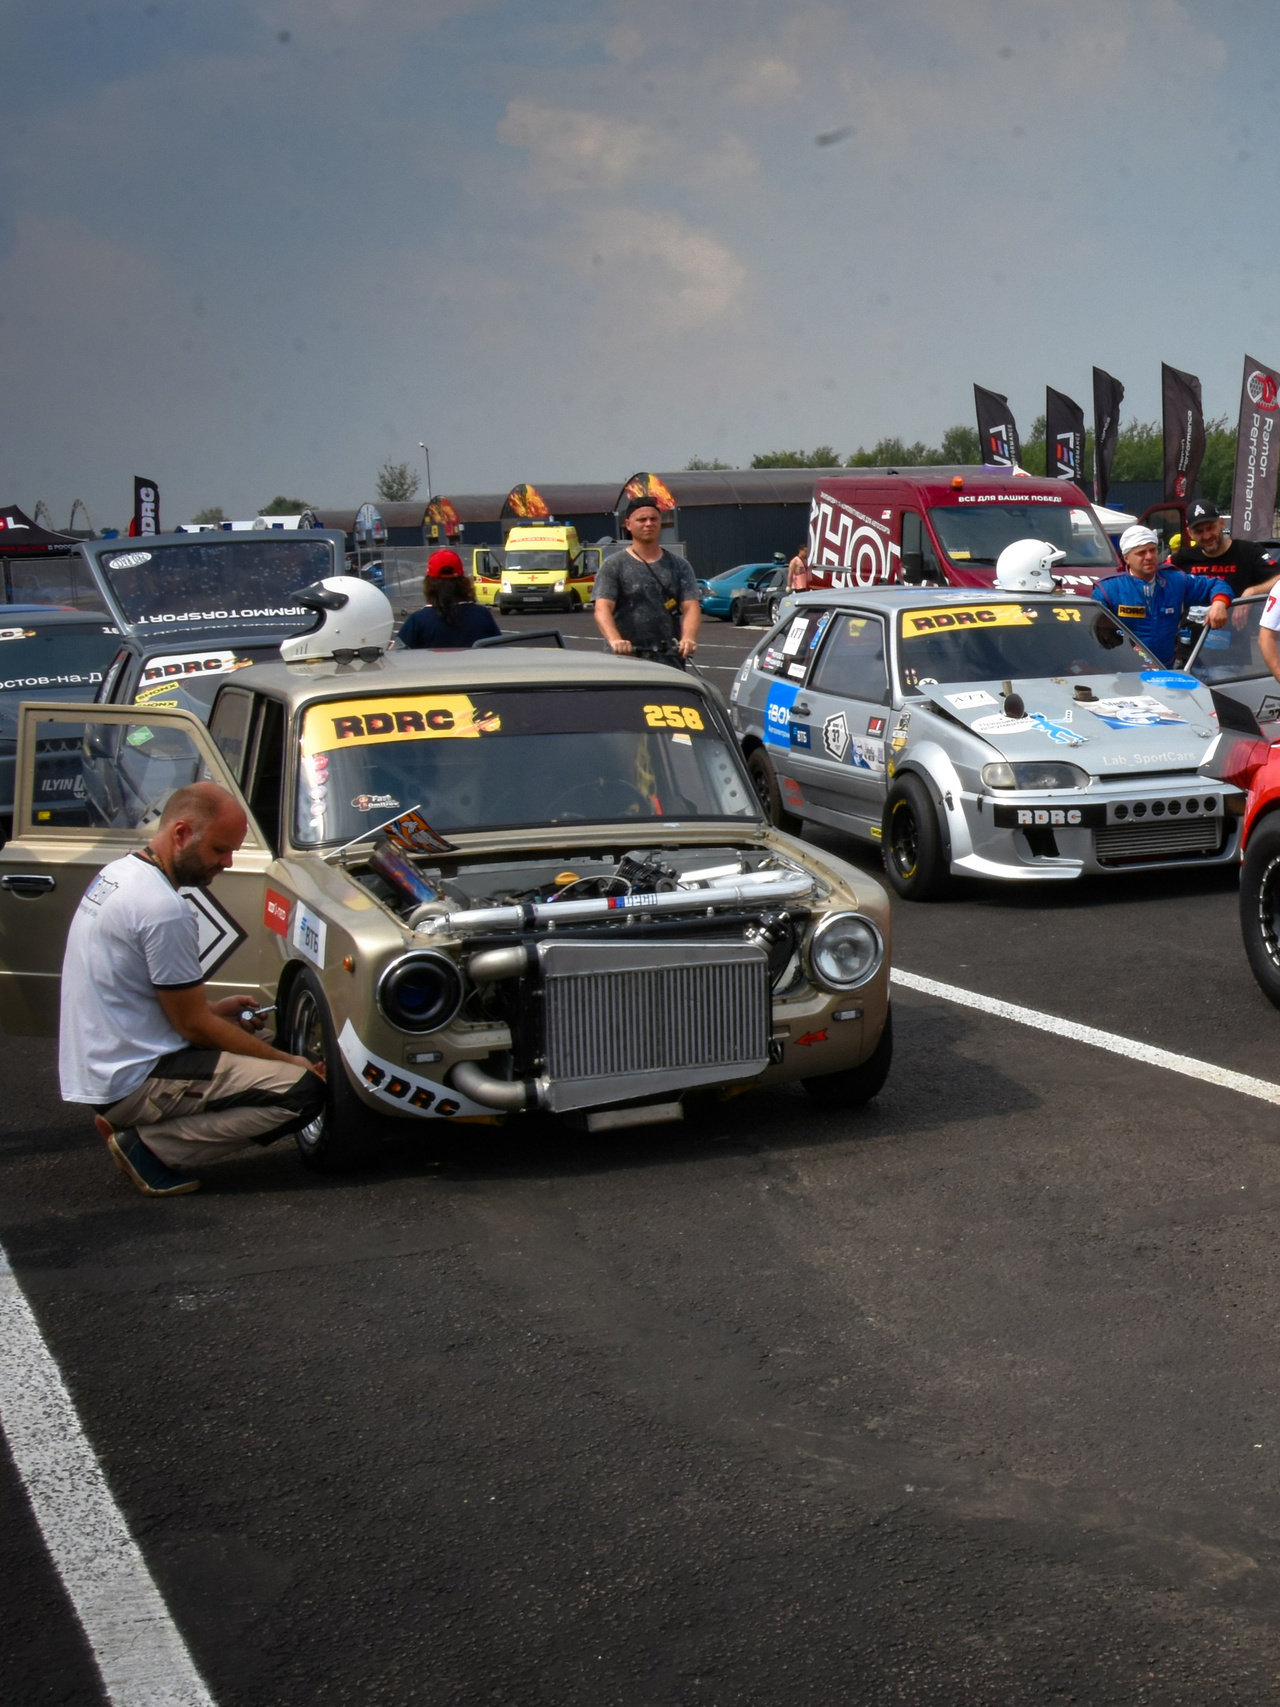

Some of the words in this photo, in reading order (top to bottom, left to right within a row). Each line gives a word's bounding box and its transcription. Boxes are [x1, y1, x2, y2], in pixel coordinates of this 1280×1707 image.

[1261, 417, 1273, 478] Ramon
[1243, 413, 1261, 531] Performance
[1211, 565, 1237, 573] RACE
[910, 610, 997, 632] RDRC
[1052, 608, 1082, 622] 37
[144, 658, 223, 681] RDRC
[331, 709, 456, 740] RDRC
[643, 704, 705, 730] 258
[1103, 751, 1196, 767] Lab_SportCars
[41, 779, 73, 791] ILYIN
[1017, 809, 1083, 825] RDRC
[304, 925, 318, 953] ВТБ
[361, 1059, 461, 1116] RDRC
